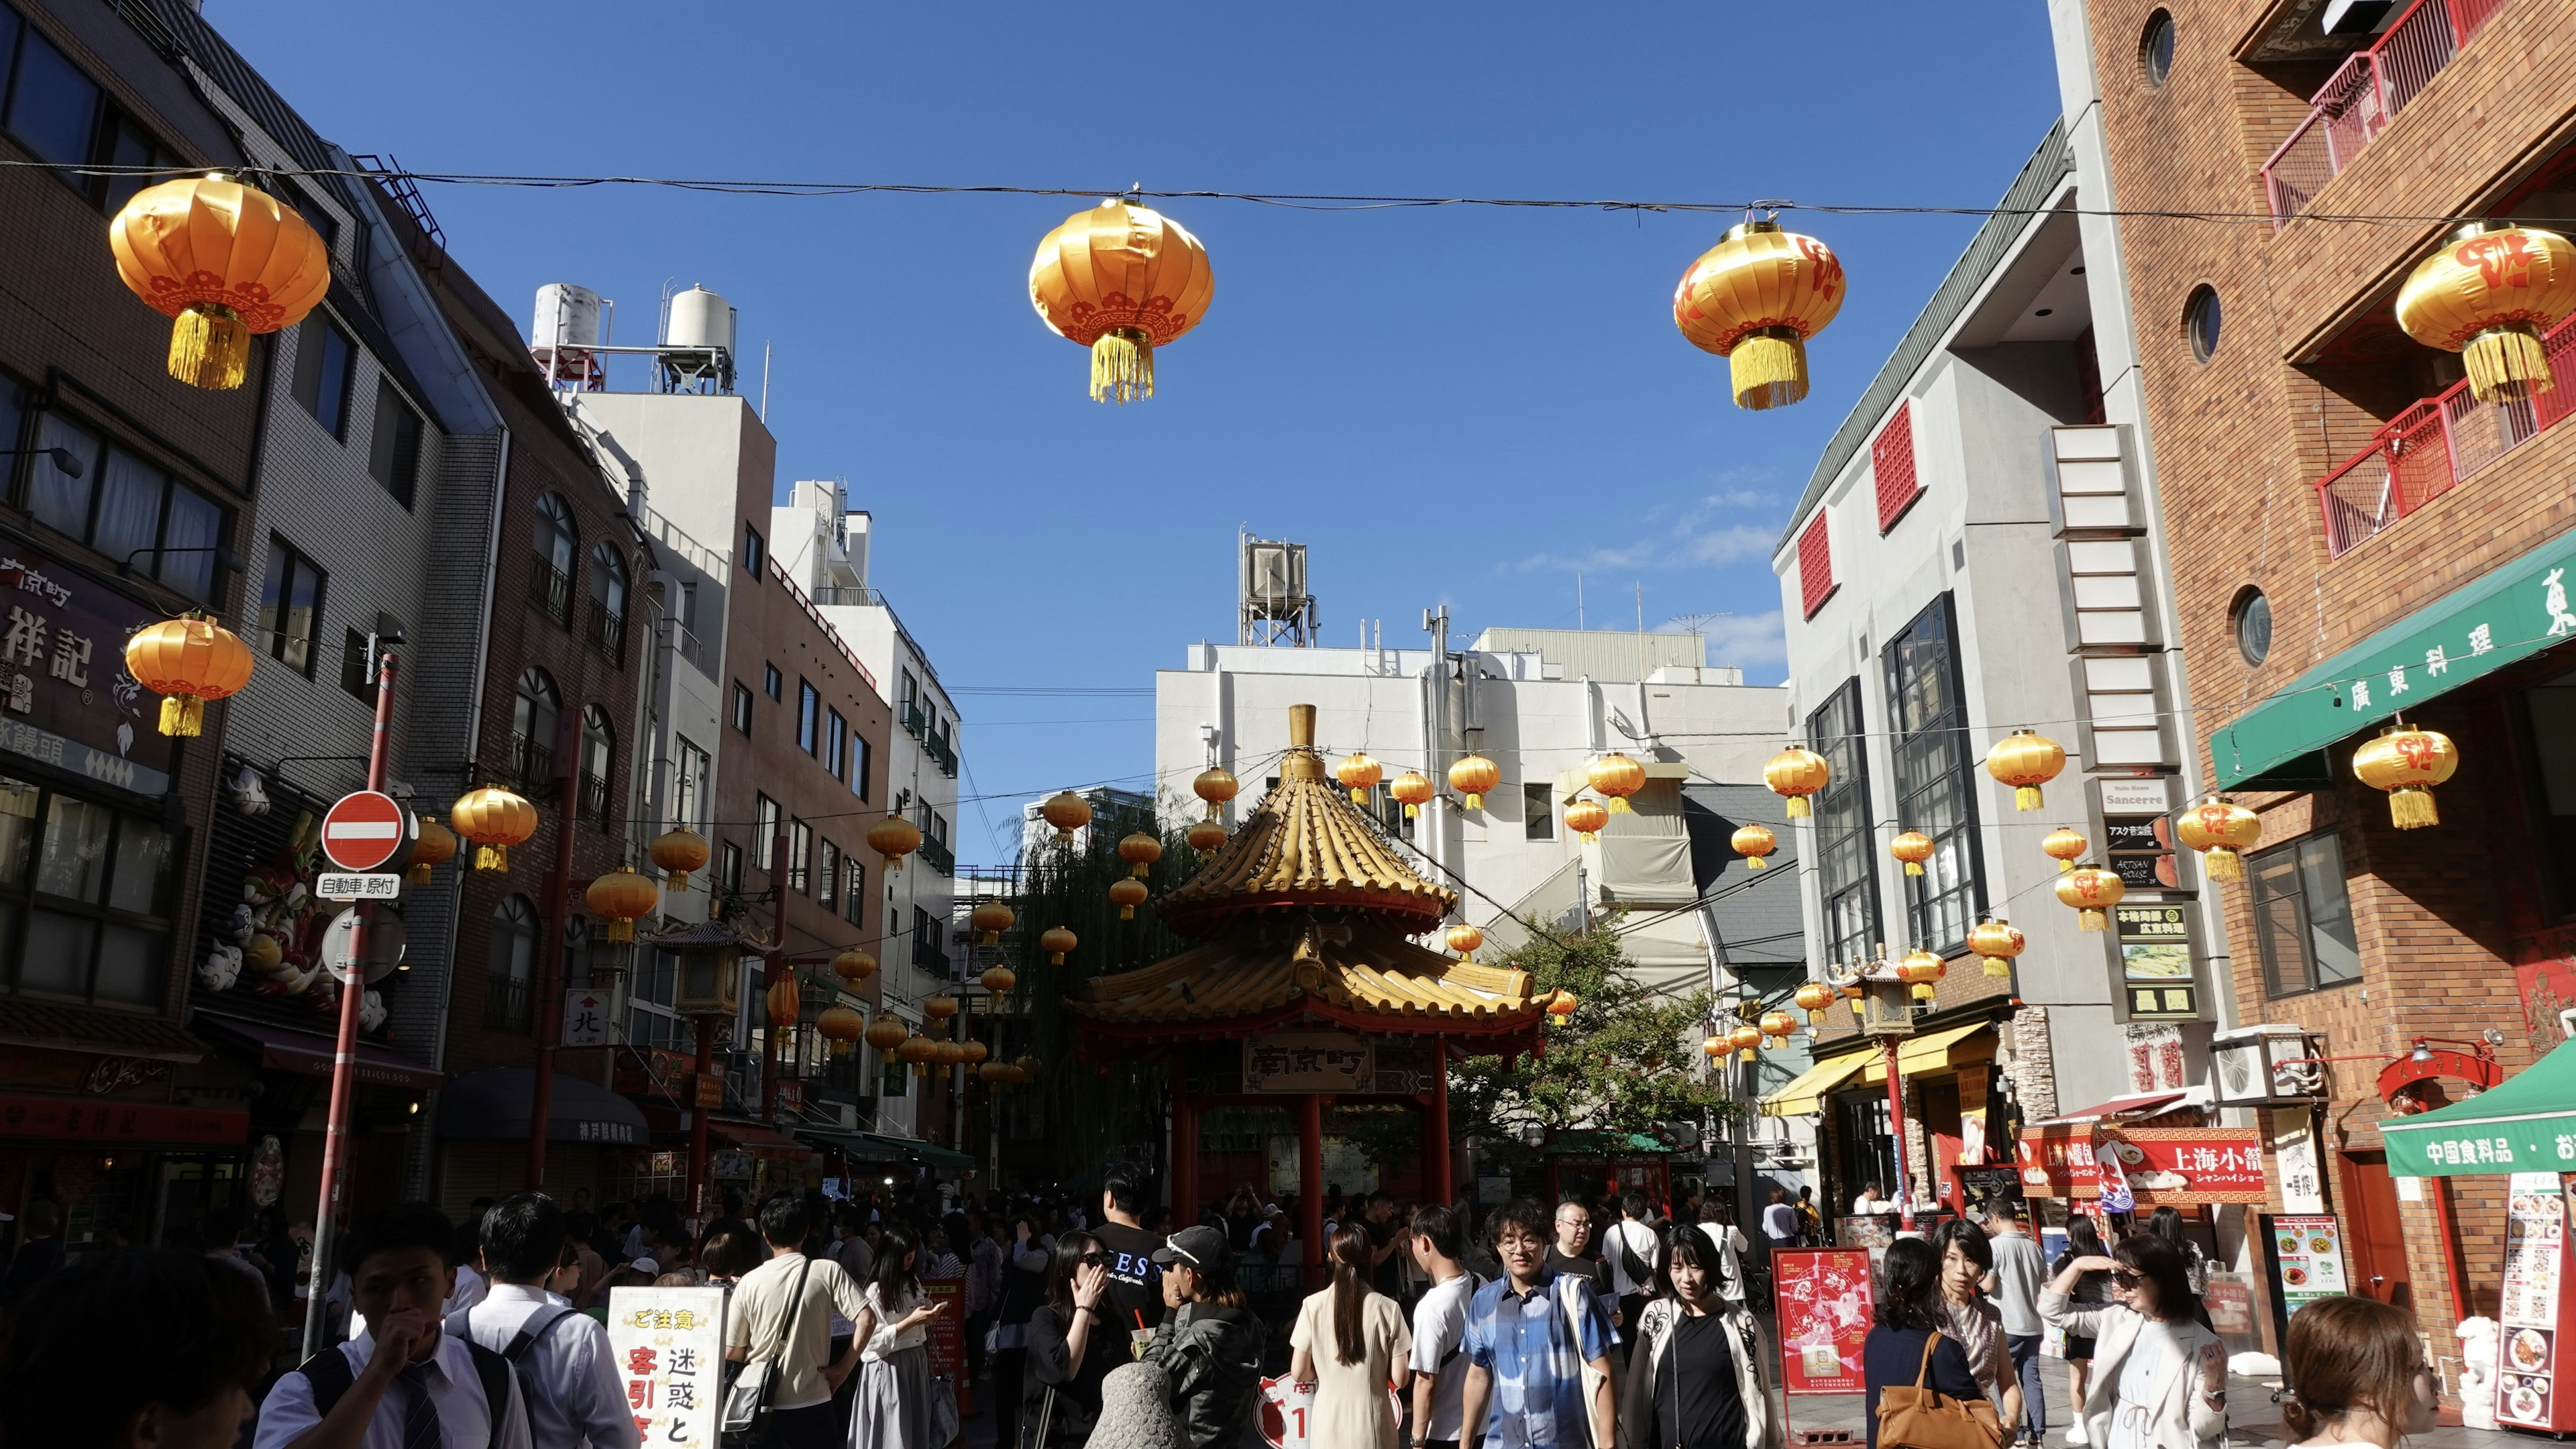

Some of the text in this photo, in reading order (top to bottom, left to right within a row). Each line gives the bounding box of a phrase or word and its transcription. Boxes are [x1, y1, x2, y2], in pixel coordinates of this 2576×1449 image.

[2351, 623, 2494, 712] 廣東料理
[2106, 795, 2163, 804] Sancerre
[2109, 826, 2153, 837] アスク音楽院
[2116, 860, 2149, 869] ARTISAN
[2122, 870, 2148, 879] HOUSE
[322, 877, 394, 894] 自動車・原付
[2118, 910, 2163, 922] 本格海鮮
[2140, 922, 2186, 934] 広東料理
[574, 1012, 600, 1032] 北
[1250, 1044, 1367, 1077] 南京町
[362, 1068, 390, 1080] DRAGON
[2047, 1142, 2095, 1167] 上海小籠包
[2426, 1138, 2513, 1165] 中国食料品
[2555, 1134, 2576, 1159] お
[1108, 1249, 1164, 1283] ESS
[635, 1308, 694, 1330] ご注意
[1291, 1407, 1305, 1439] 1
